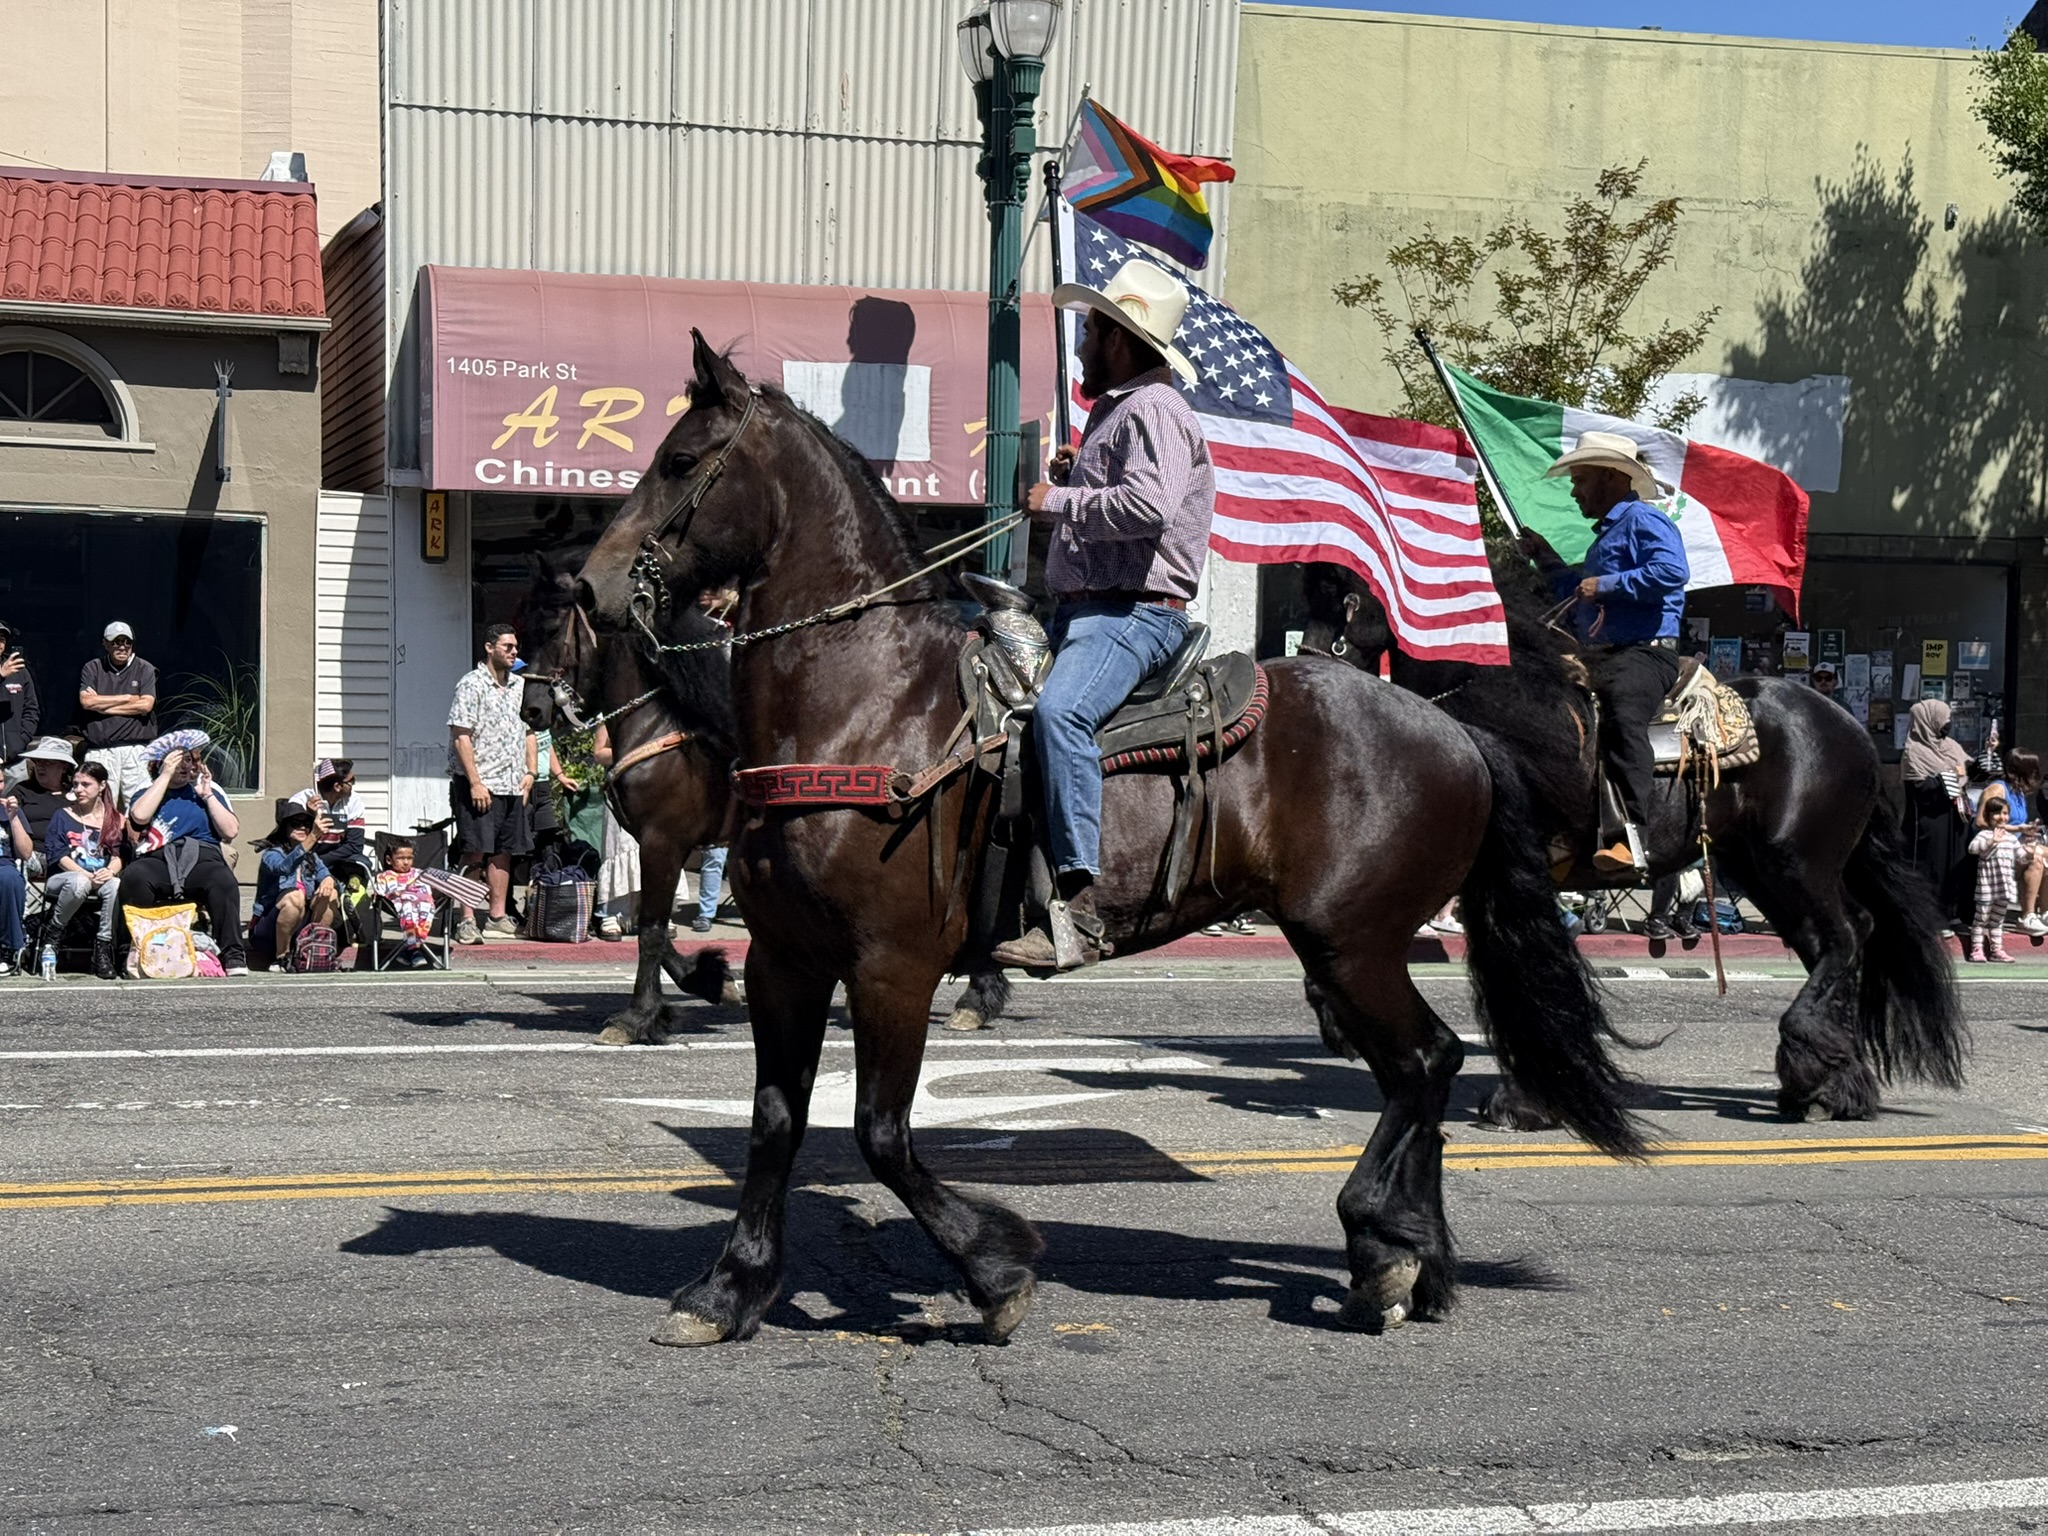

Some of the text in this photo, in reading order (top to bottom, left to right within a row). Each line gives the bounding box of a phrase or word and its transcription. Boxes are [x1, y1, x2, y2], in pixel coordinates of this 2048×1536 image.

[447, 357, 497, 376] 1405
[503, 360, 551, 379] Park
[555, 362, 577, 380] St
[491, 385, 692, 452] AR
[474, 458, 642, 489] Chines
[429, 499, 443, 550] ARK
[1925, 643, 1944, 651] IMP
